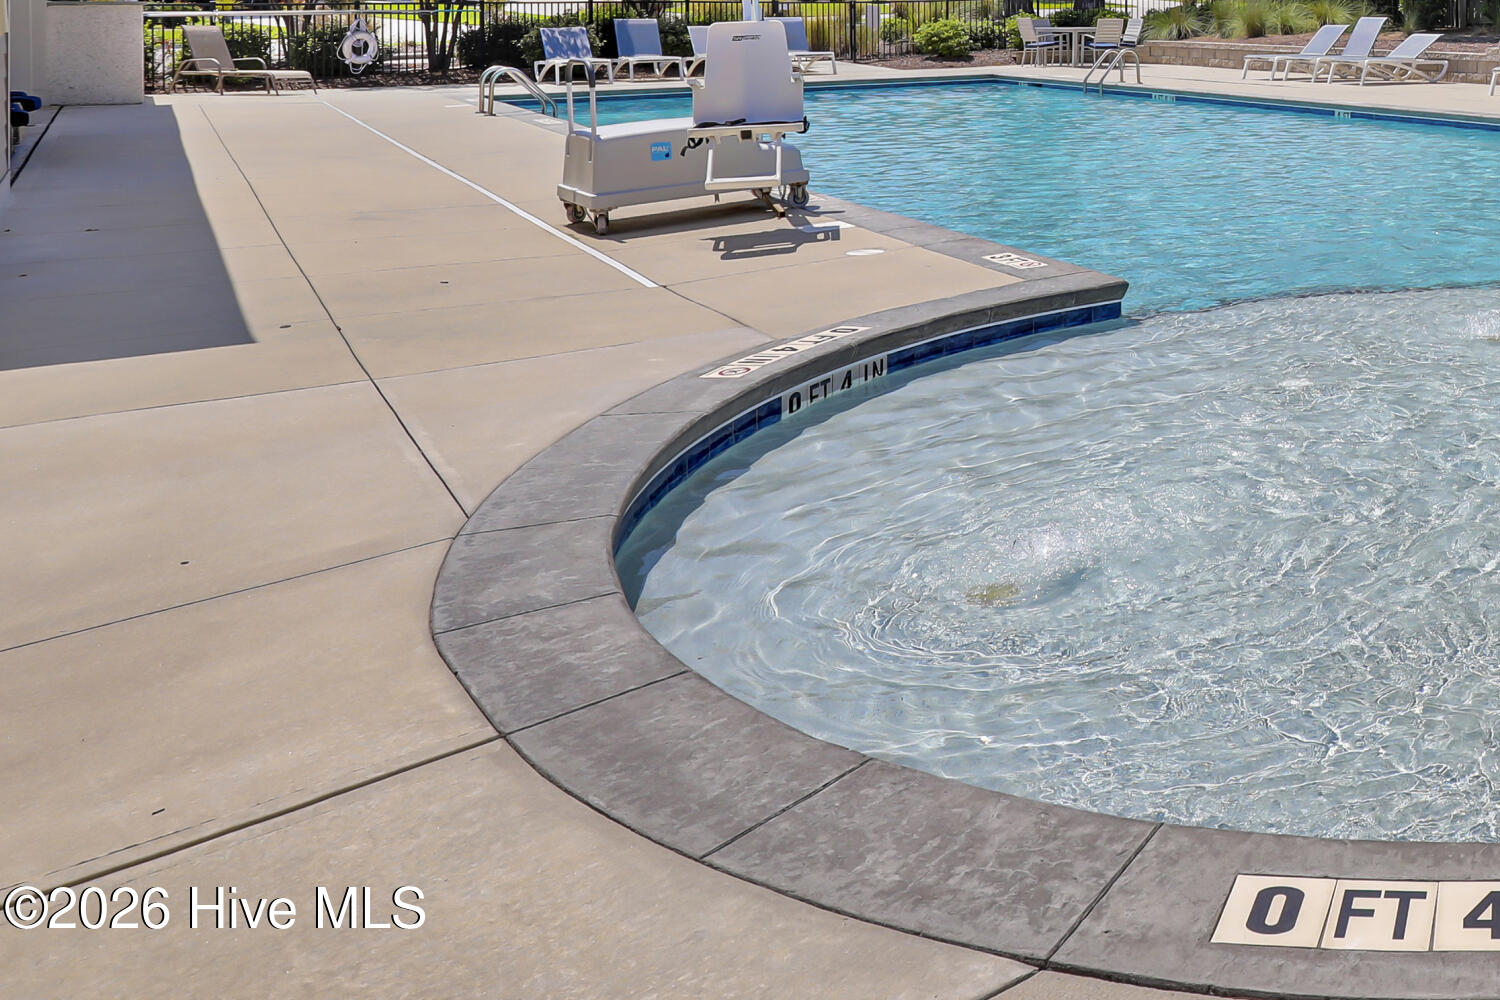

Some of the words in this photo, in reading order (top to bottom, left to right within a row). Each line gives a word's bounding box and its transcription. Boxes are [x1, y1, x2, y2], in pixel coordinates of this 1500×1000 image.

[799, 335, 837, 344] FT
[737, 355, 780, 364] IN
[788, 391, 802, 414] 0
[809, 377, 831, 404] FT
[840, 369, 853, 391] 4
[864, 358, 884, 382] IN
[1245, 886, 1305, 935] 0
[1333, 889, 1428, 941] FT
